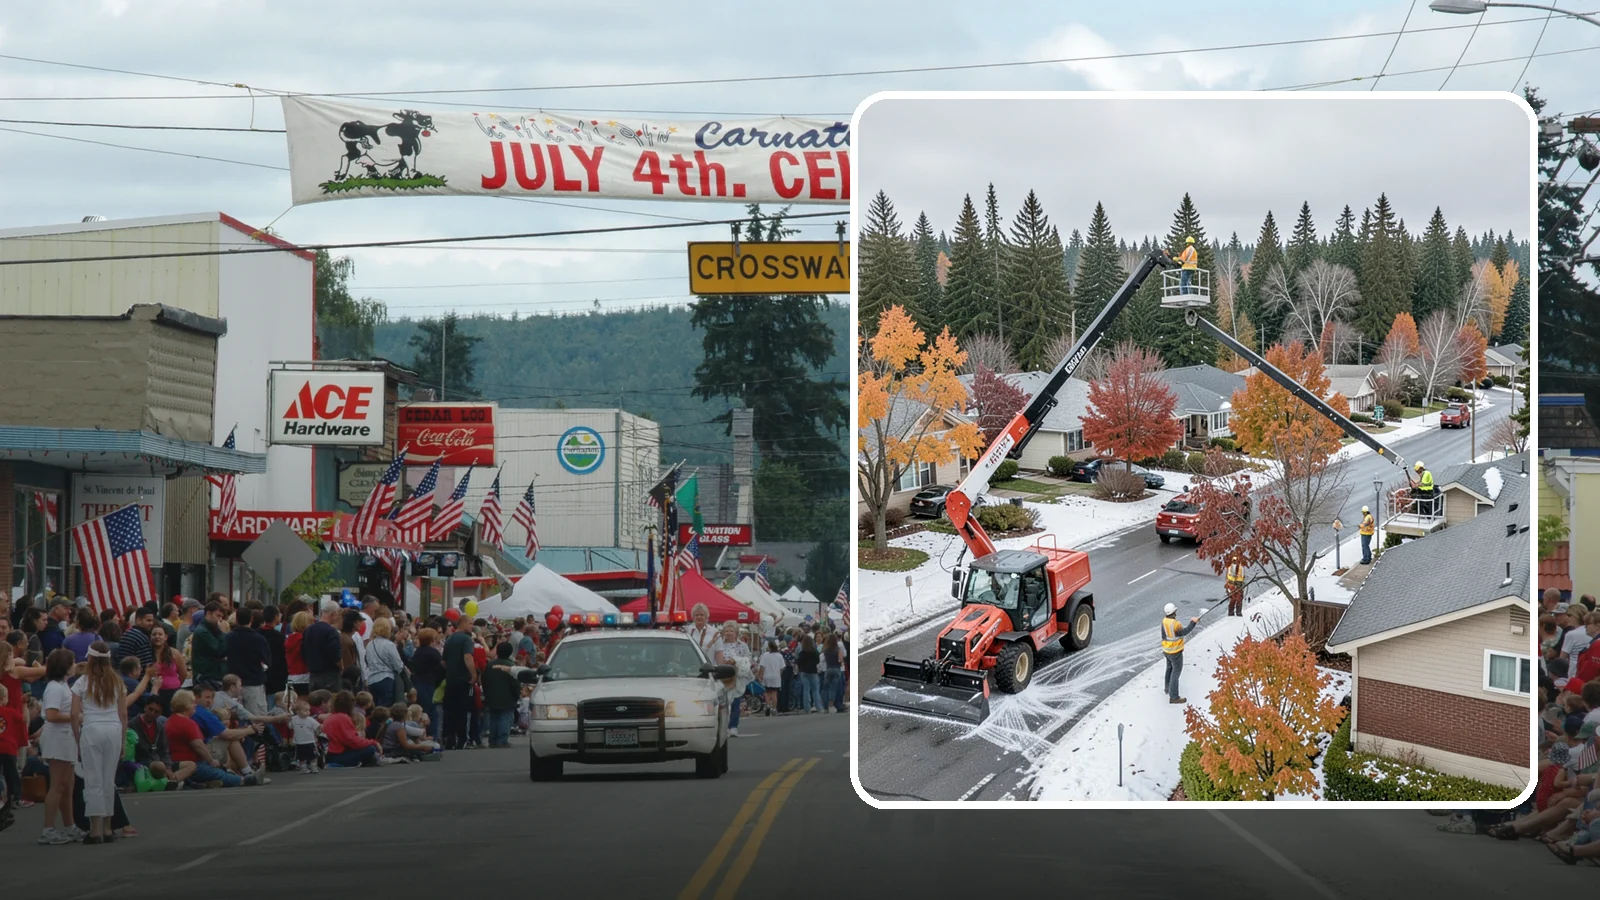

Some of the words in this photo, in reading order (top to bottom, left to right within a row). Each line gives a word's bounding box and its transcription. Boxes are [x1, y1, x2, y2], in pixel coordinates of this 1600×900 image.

[694, 121, 850, 149] Carnat
[481, 141, 605, 192] JULY
[632, 150, 746, 197] 4th.
[697, 254, 850, 280] CROSSWA
[283, 380, 373, 420] ACE
[406, 409, 452, 422] CEDAR
[284, 421, 370, 436] Hardware
[416, 428, 477, 447] Coca-Cola
[83, 485, 93, 494] St.
[95, 485, 124, 495] Vincent
[126, 485, 136, 495] de
[138, 485, 155, 495] Paul
[81, 503, 153, 522] THT
[688, 526, 741, 535] CRNATION
[699, 535, 730, 543] GLASS
